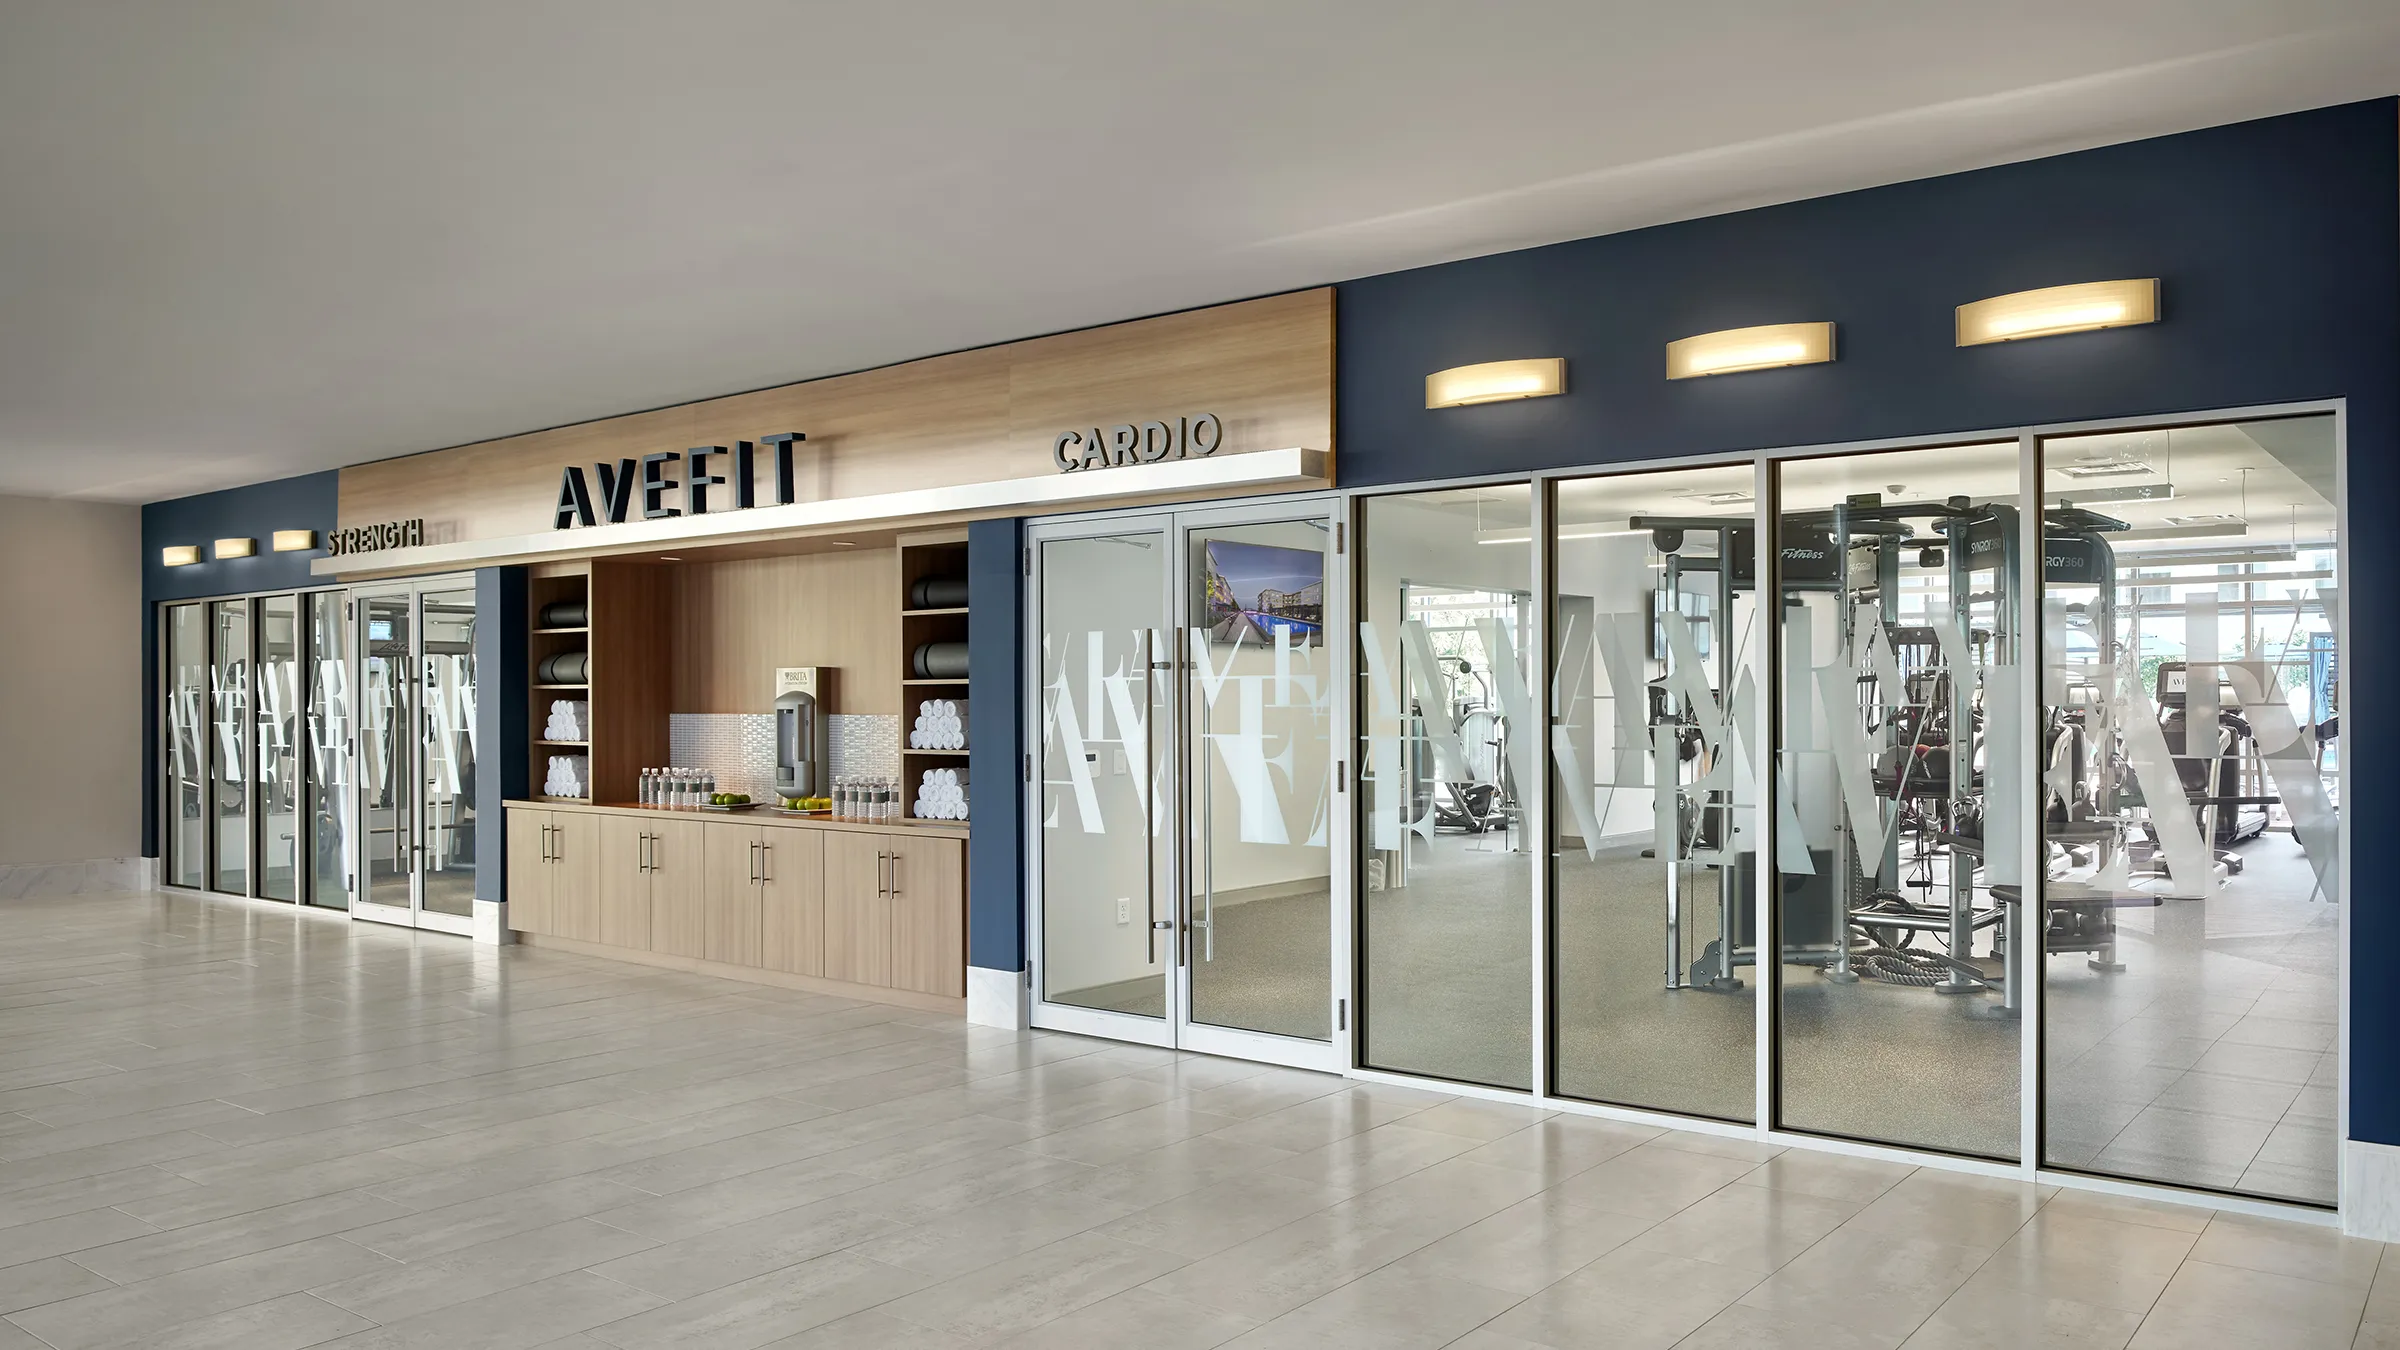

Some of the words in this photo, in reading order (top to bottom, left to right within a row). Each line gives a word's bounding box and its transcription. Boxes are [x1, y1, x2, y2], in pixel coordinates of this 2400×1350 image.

[1053, 413, 1223, 471] CARDIO
[553, 432, 806, 530] AVEFIT
[327, 518, 424, 556] STRENGTH
[2046, 556, 2084, 568] RGY360
[790, 671, 808, 681] BRITA
